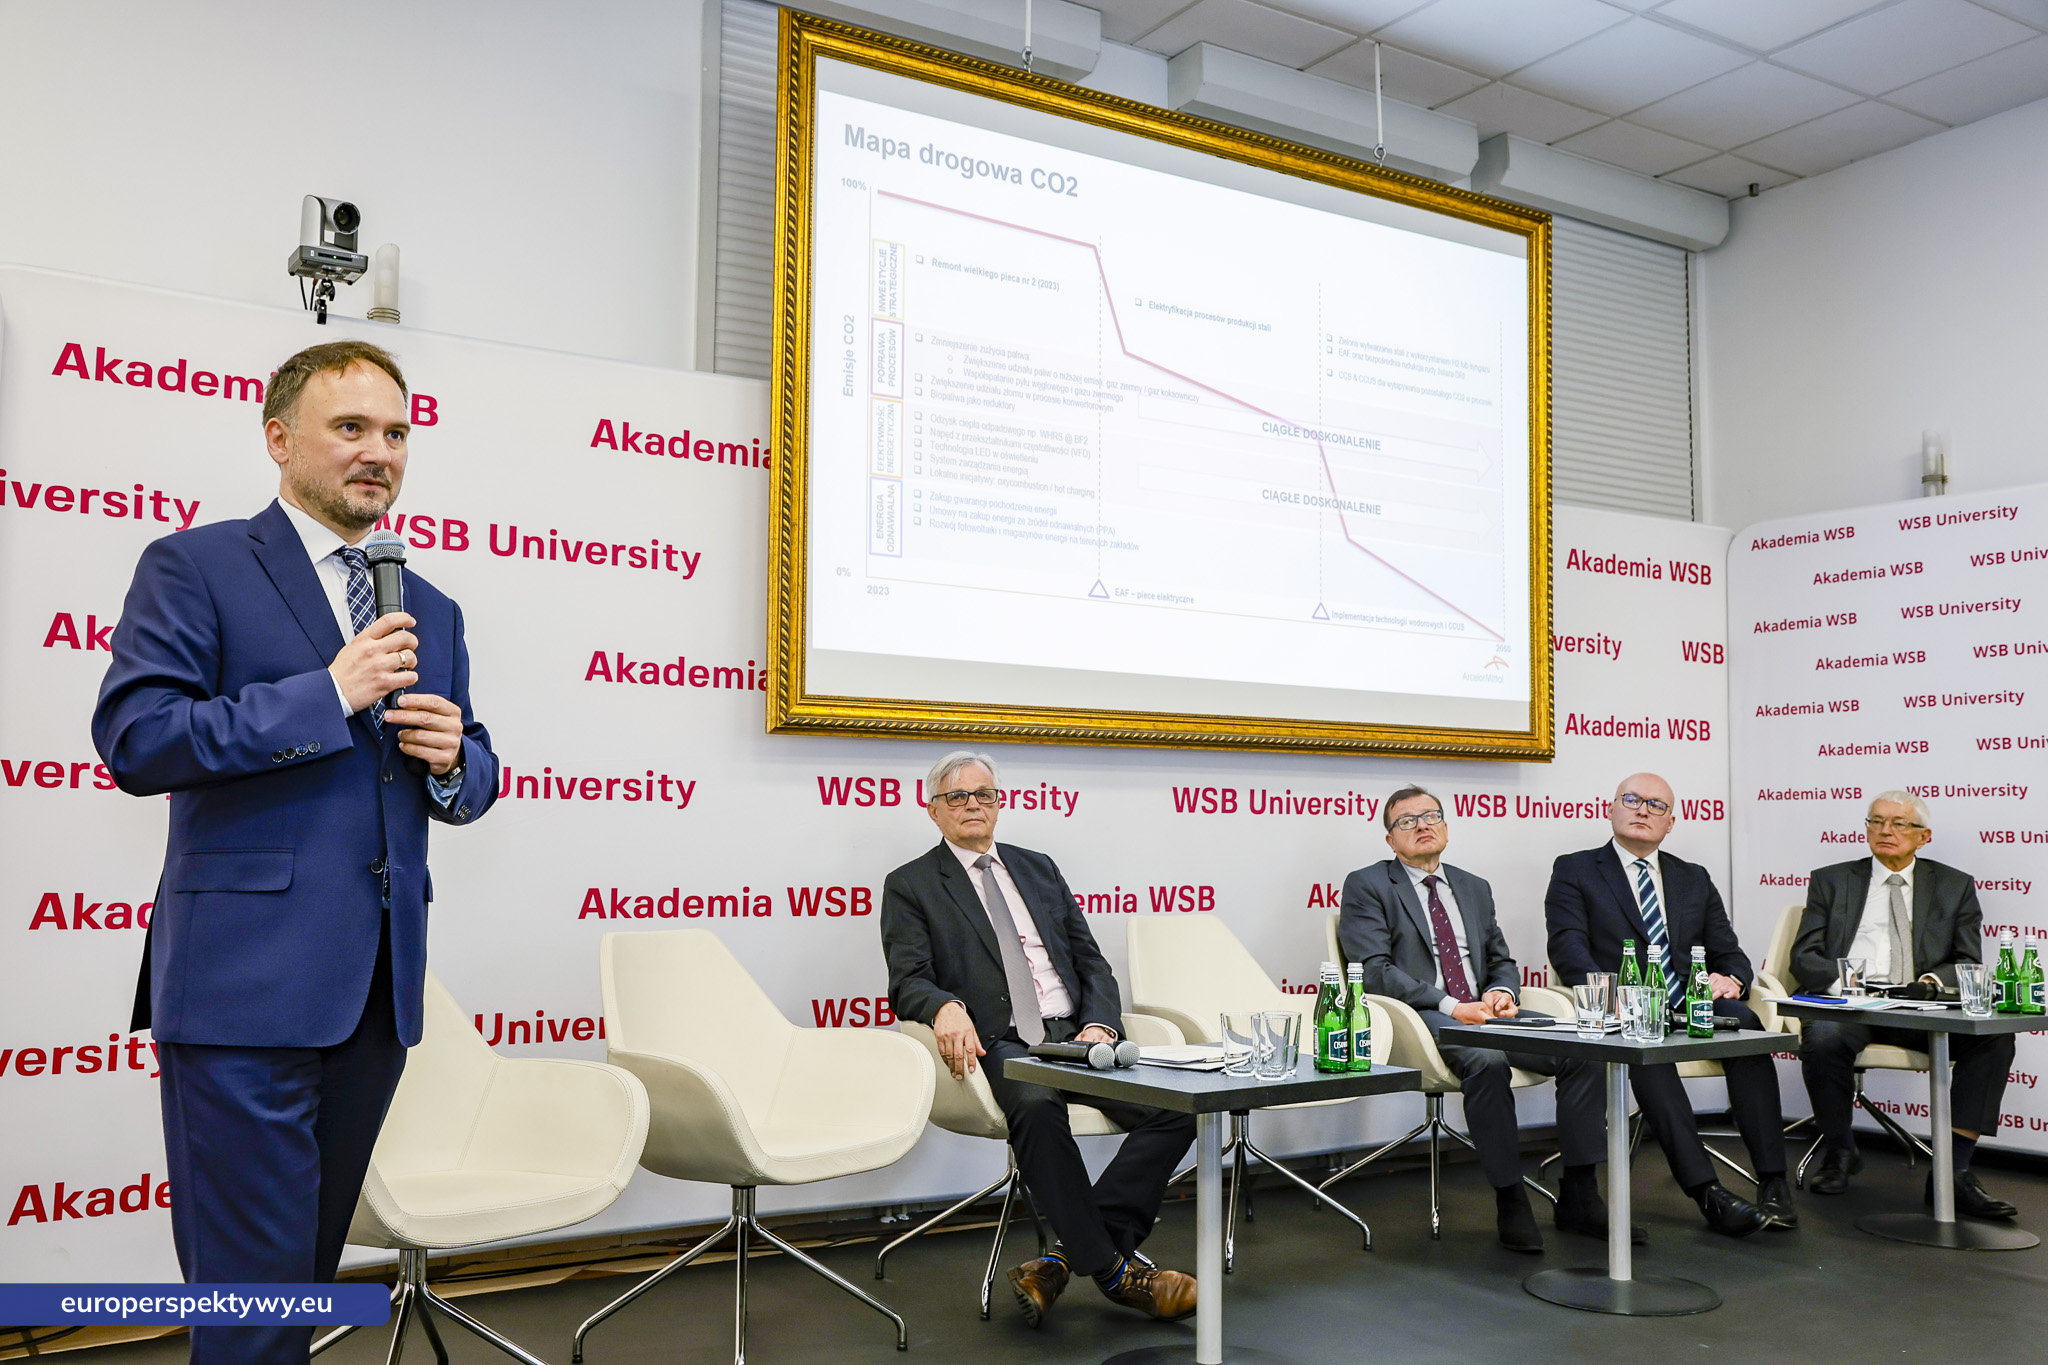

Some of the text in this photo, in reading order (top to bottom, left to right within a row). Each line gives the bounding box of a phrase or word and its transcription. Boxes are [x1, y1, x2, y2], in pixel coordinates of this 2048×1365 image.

[844, 123, 1078, 198] Mapa drogowa CO2
[841, 177, 867, 191] 100%
[931, 258, 961, 272] Remont
[964, 265, 999, 280] wielkiego
[1000, 272, 1020, 284] pieca
[1022, 276, 1030, 285] nr
[1038, 279, 1060, 292] (2023)
[1148, 300, 1193, 318] Elektryfikacja
[843, 314, 856, 397] Emisje CO2
[52, 343, 275, 403] Akadem
[1262, 422, 1381, 450] CIĄGŁE DOSKONALENIE
[0, 469, 200, 531] iversity
[1262, 488, 1381, 515] CIĄGŁE DOSKONALENIE
[1898, 506, 2019, 531] WSB University
[1751, 526, 1856, 551] Akademia WSB
[490, 524, 701, 580] University
[1970, 551, 2006, 568] WSB
[836, 567, 851, 577] 0%
[1567, 548, 1711, 585] Akademia WSB
[1813, 561, 1924, 585] Akademia WSB
[866, 584, 890, 596] 2023
[1900, 598, 2022, 620] WSB University
[1753, 612, 1858, 634] Akademia WSB
[1553, 633, 1622, 660] versity
[1682, 641, 1724, 664] WSB
[1973, 643, 2009, 659] WSB
[1815, 650, 1927, 670] Akademia WSB
[1755, 699, 1860, 717] Akademia WSB
[1903, 689, 2025, 708] WSB University
[1565, 713, 1710, 741] Akademia WSB
[1818, 740, 1930, 757] Akademia WSB
[1976, 737, 2012, 751] WSB
[818, 776, 901, 807] WSB
[1757, 787, 1863, 801] Akademia WSB
[1906, 784, 2028, 800] WSB University
[1173, 787, 1379, 821] WSB University
[1454, 794, 1608, 819] WSB Universit
[1682, 799, 1724, 821] WSB
[1820, 831, 1866, 844] Akade
[1979, 830, 2016, 844] WSB
[1974, 877, 2032, 895] versity
[579, 887, 872, 919] Akademia WSB
[1073, 885, 1215, 913] emia WSB
[812, 997, 896, 1028] WSB
[475, 1010, 606, 1046] Unive
[0, 1033, 161, 1078] ersit
[1906, 1103, 1930, 1118] WS
[8, 1173, 172, 1225] Akade
